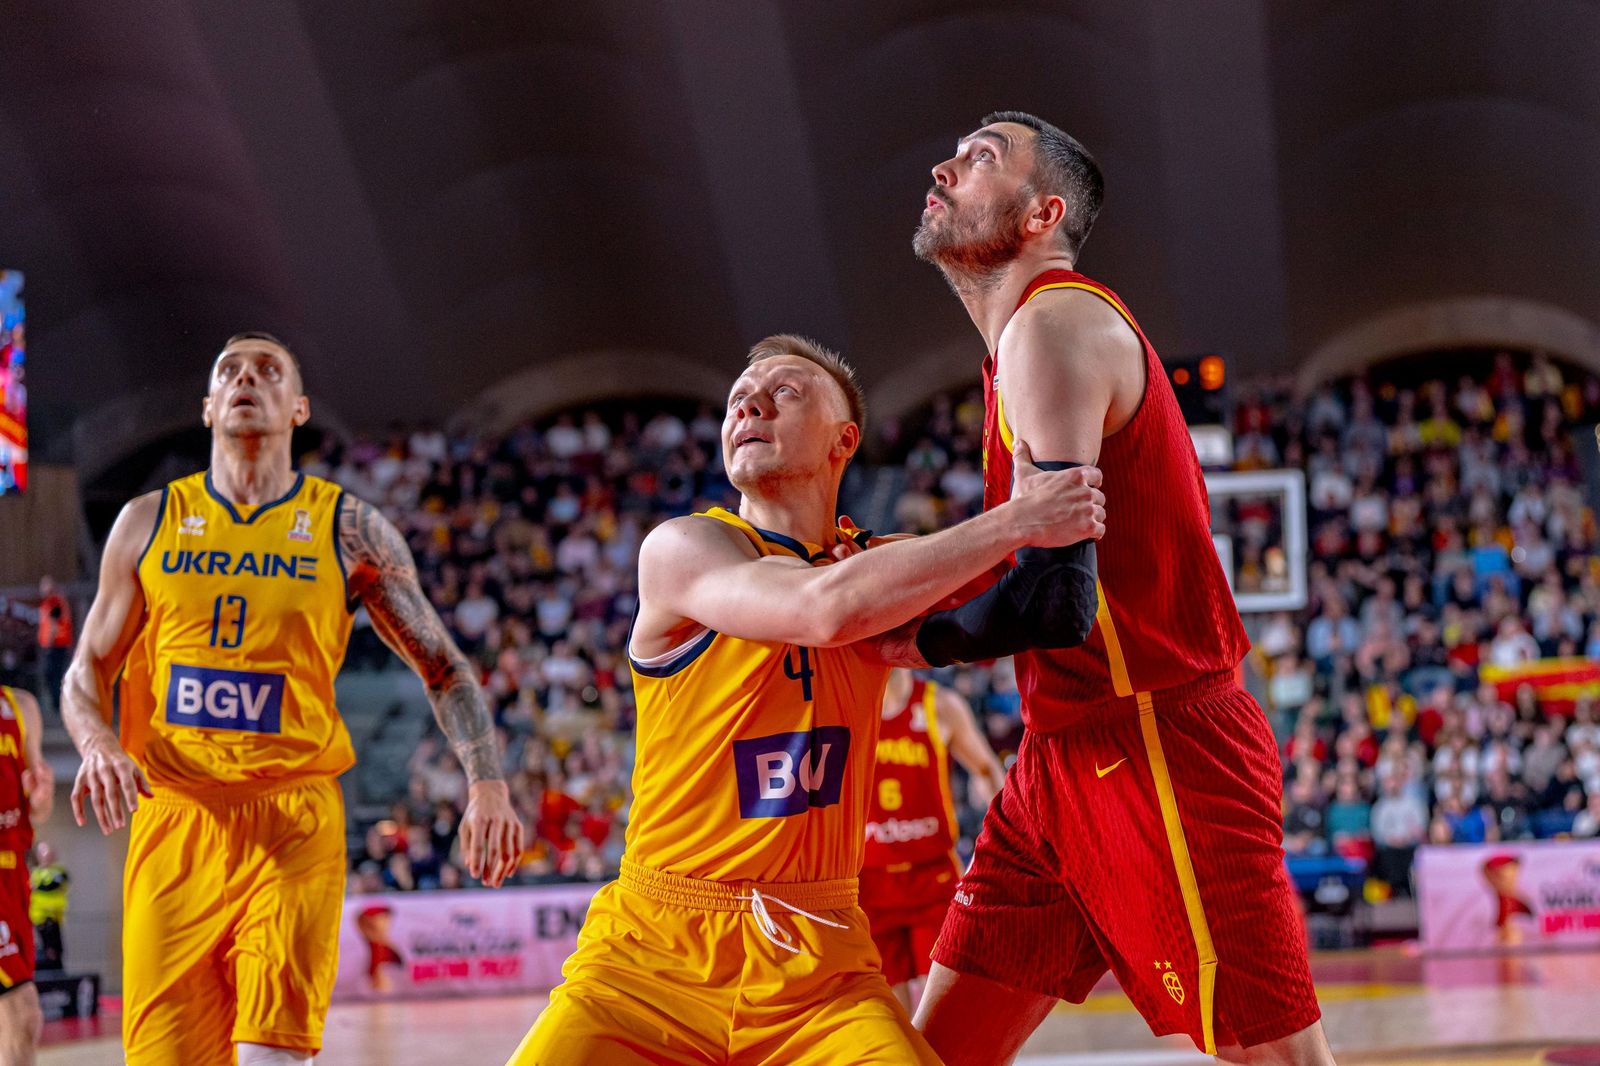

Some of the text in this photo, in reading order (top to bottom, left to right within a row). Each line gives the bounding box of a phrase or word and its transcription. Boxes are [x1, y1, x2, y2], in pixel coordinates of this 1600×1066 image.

[162, 550, 319, 581] UKRAINE
[209, 594, 248, 649] 13
[784, 644, 814, 701] 4
[177, 677, 272, 721] BGV
